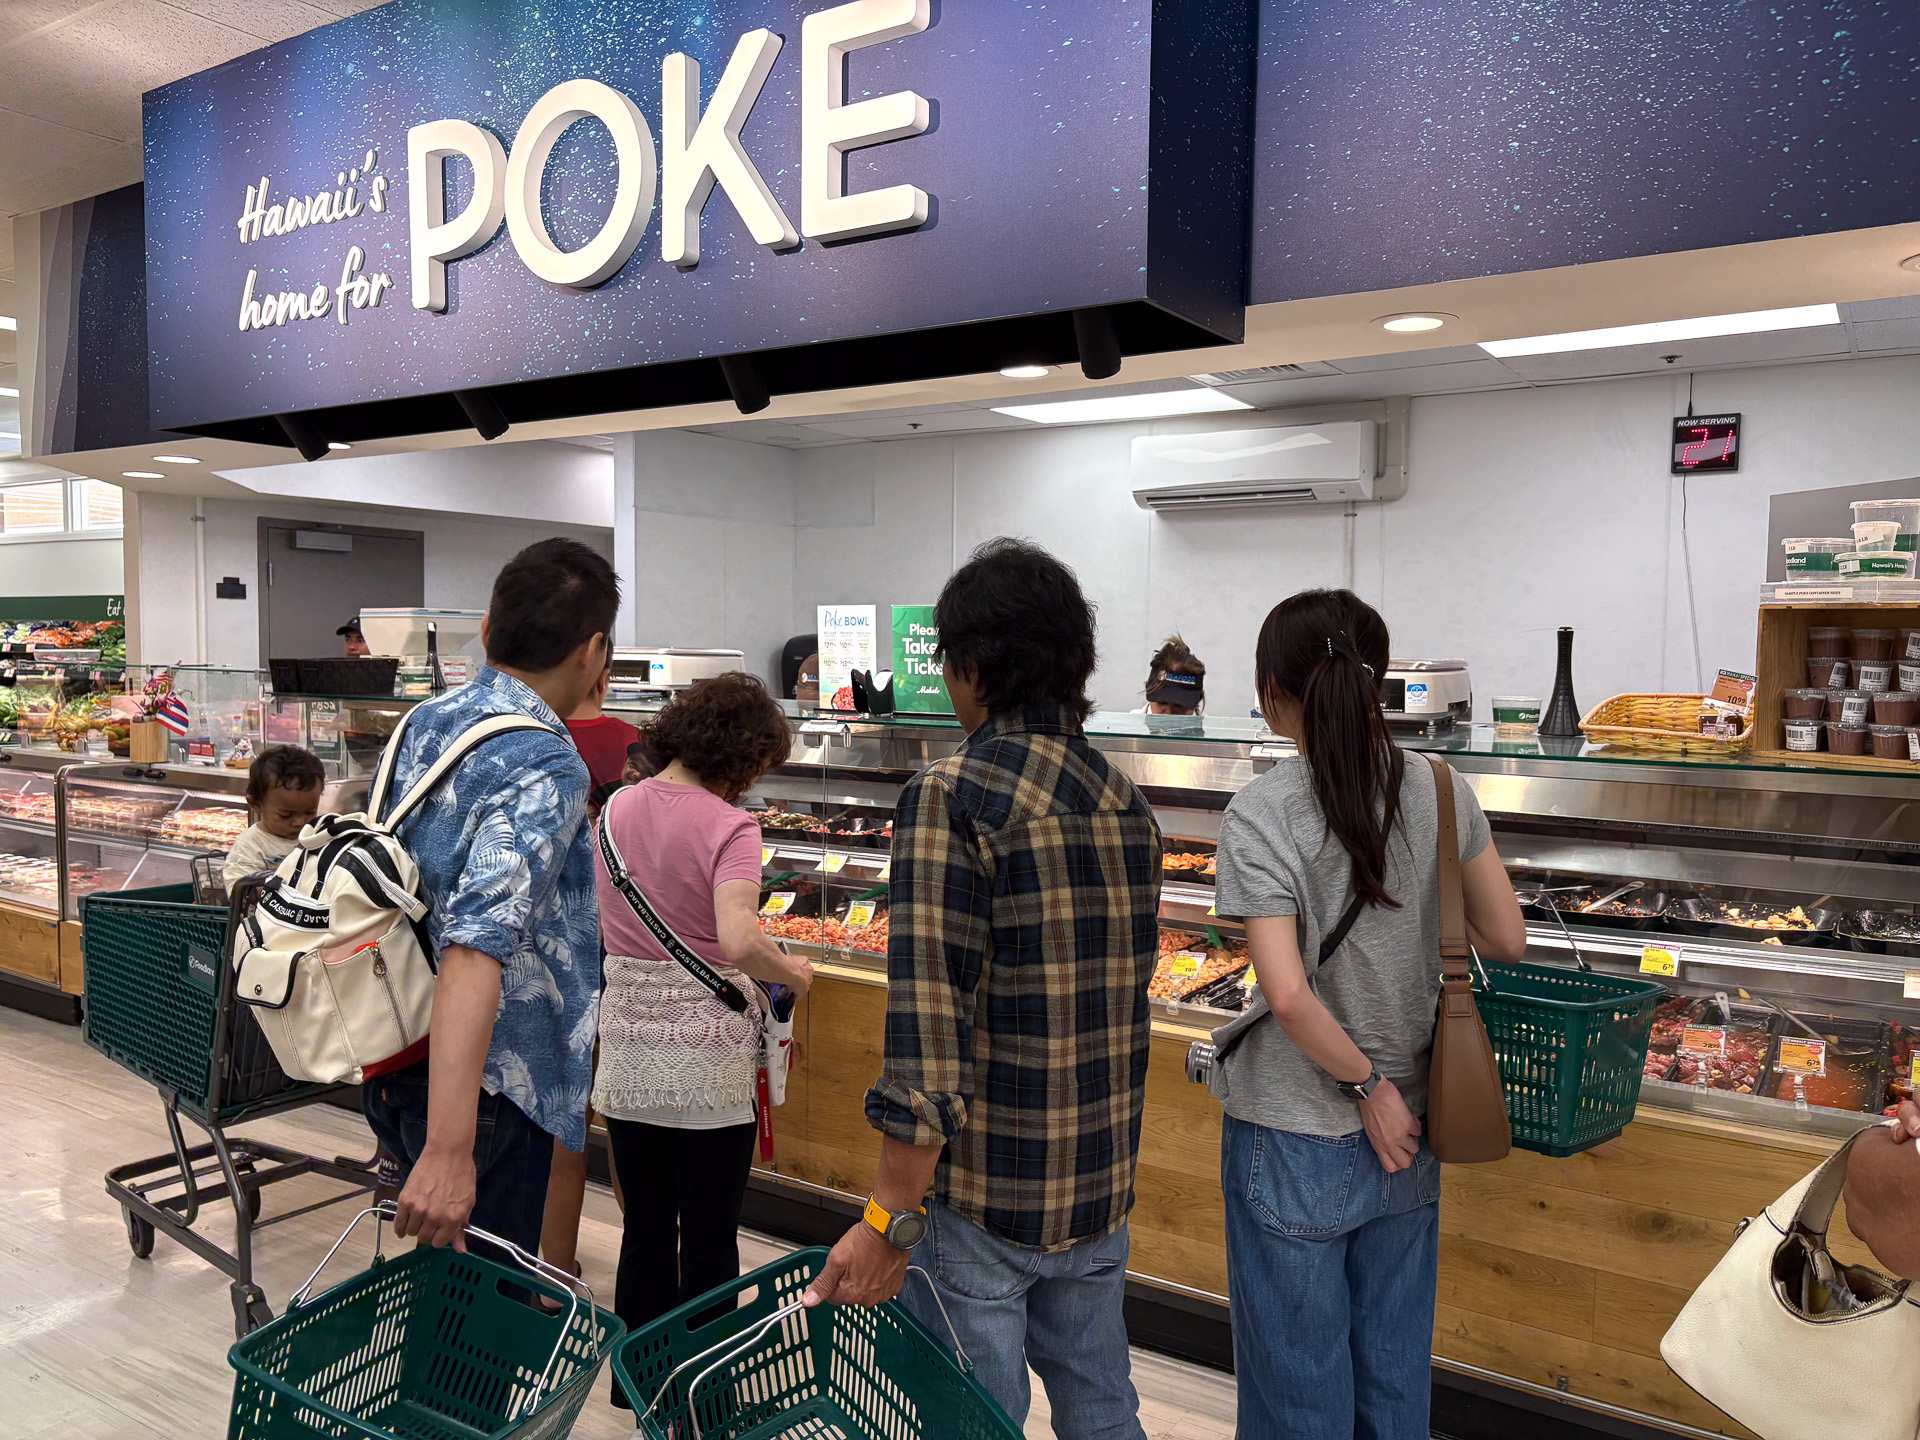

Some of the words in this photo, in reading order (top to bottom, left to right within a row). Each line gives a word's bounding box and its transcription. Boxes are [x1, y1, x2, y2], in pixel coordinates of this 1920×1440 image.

[407, 0, 933, 314] POKE
[238, 150, 388, 245] Hawaii's
[238, 269, 330, 333] home
[335, 246, 392, 326] for
[1677, 419, 1698, 427] NOW
[1699, 416, 1736, 426] SERVING
[1681, 428, 1734, 465] 21
[106, 597, 122, 617] Eat
[824, 610, 844, 630] Poke
[844, 616, 870, 626] BOWL
[909, 623, 939, 636] Plea
[901, 637, 938, 655] Take
[903, 657, 944, 676] Ticke
[627, 891, 667, 939] CASTELBAJAC
[675, 948, 723, 990] CASTELBAJAC
